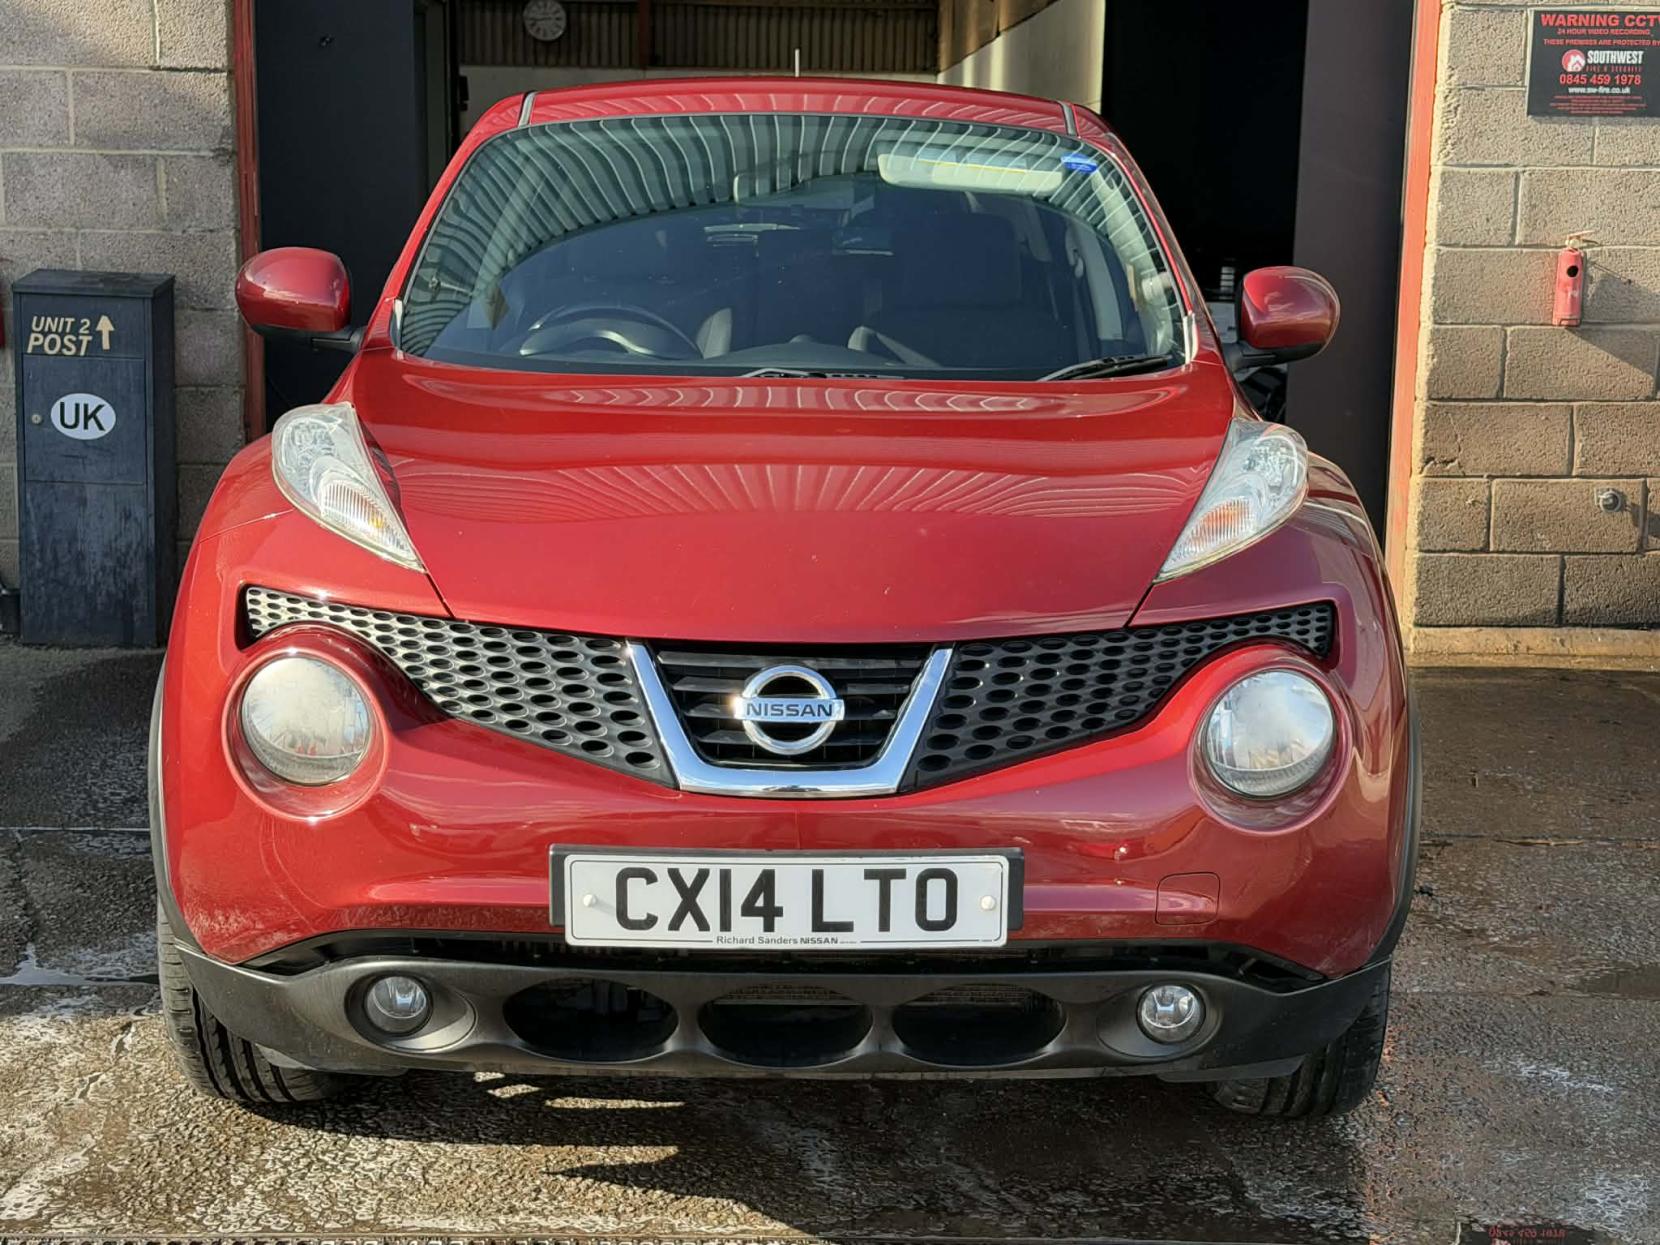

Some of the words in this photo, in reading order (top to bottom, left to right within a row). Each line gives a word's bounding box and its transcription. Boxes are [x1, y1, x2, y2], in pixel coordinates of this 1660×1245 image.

[1540, 14, 1620, 27] WARNING
[1543, 38, 1565, 46] THESE
[1587, 50, 1644, 64] SOUTHWEST
[1559, 74, 1587, 85] 0845
[1590, 74, 1611, 85] 459
[1614, 74, 1641, 85] 1978
[31, 316, 75, 333] UNIT
[79, 318, 91, 334] 2
[27, 333, 93, 356] POST
[59, 401, 106, 431] UK
[746, 703, 833, 717] NISSAN
[615, 867, 784, 932] CX14
[811, 868, 958, 932] LTO
[716, 935, 755, 945] Richard
[758, 936, 798, 945] Sanders
[800, 937, 838, 945] NISSAN
